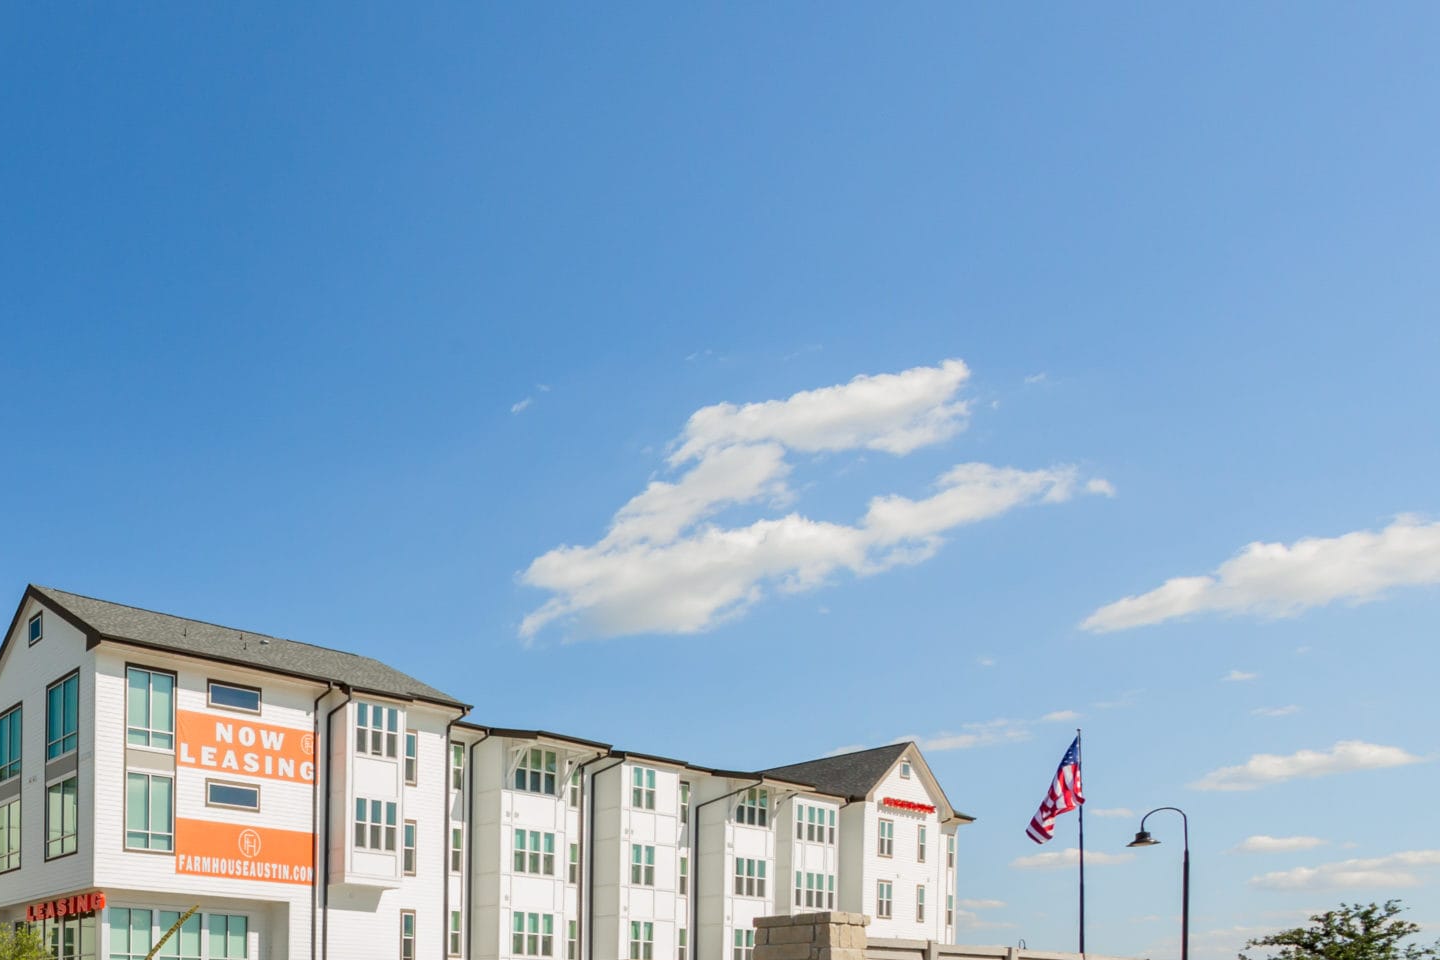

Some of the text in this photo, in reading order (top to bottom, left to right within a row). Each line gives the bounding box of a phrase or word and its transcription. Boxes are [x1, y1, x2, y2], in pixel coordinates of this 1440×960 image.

[216, 722, 284, 751] NOW
[180, 742, 314, 780] LEASING
[26, 891, 106, 922] LEASING
